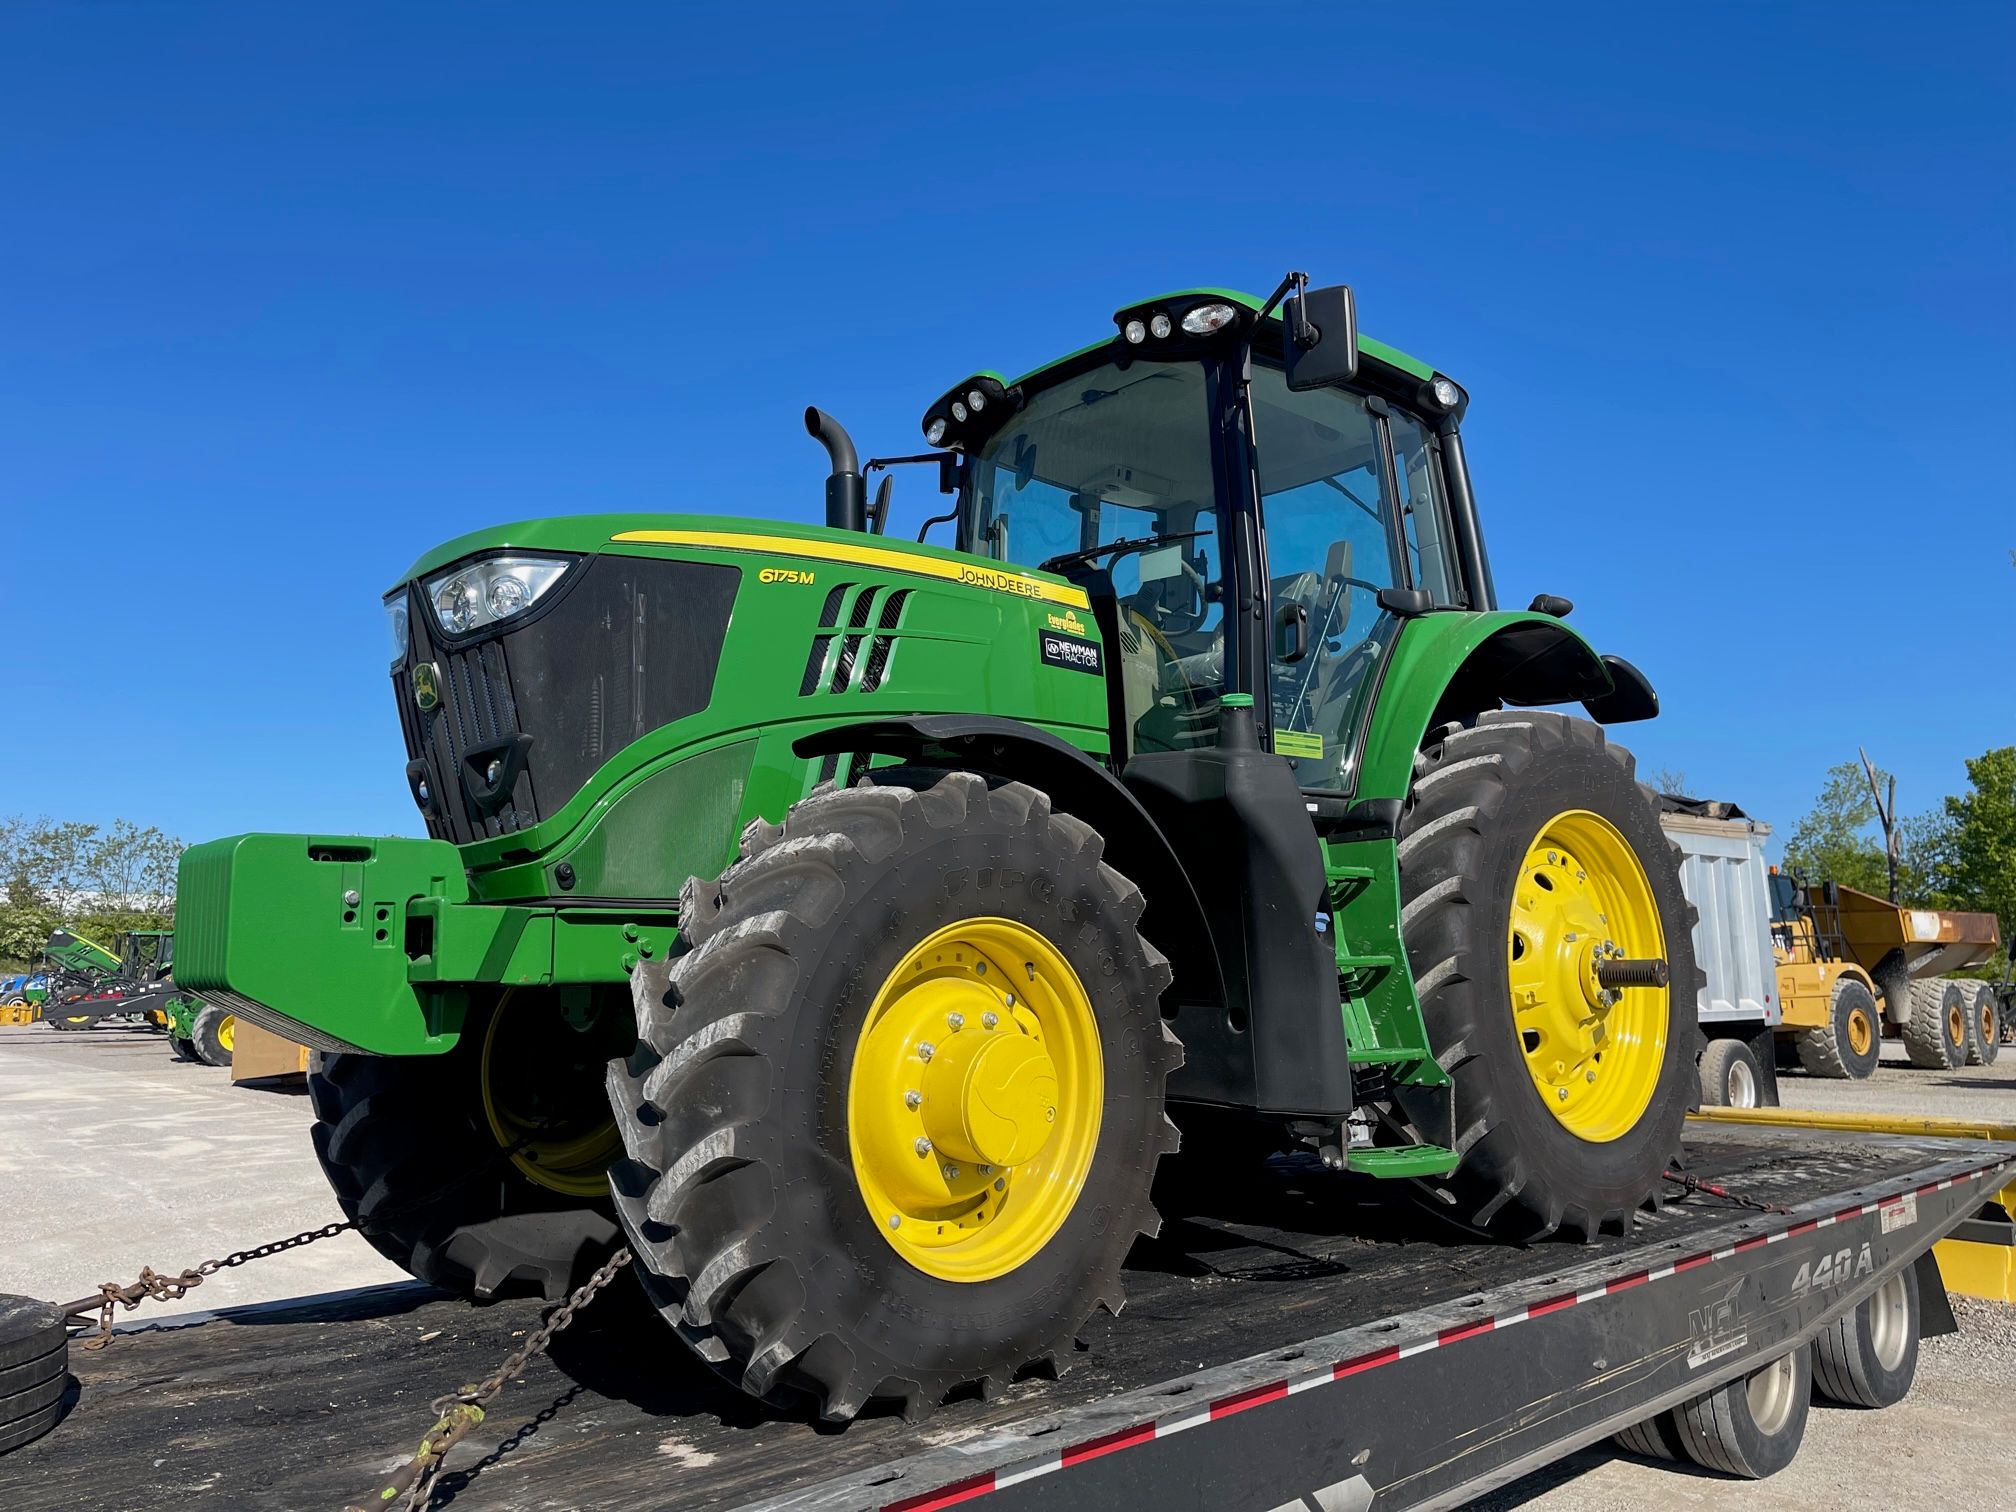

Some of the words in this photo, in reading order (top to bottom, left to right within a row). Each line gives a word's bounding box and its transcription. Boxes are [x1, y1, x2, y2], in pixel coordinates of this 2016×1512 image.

[758, 568, 815, 585] 6175M
[957, 566, 996, 587] JOHN
[997, 574, 1041, 597] DEERE
[1059, 641, 1097, 658] NEWMAN
[1060, 650, 1098, 668] TRACTOR
[1791, 1247, 1852, 1297] 440
[1853, 1241, 1875, 1279] A
